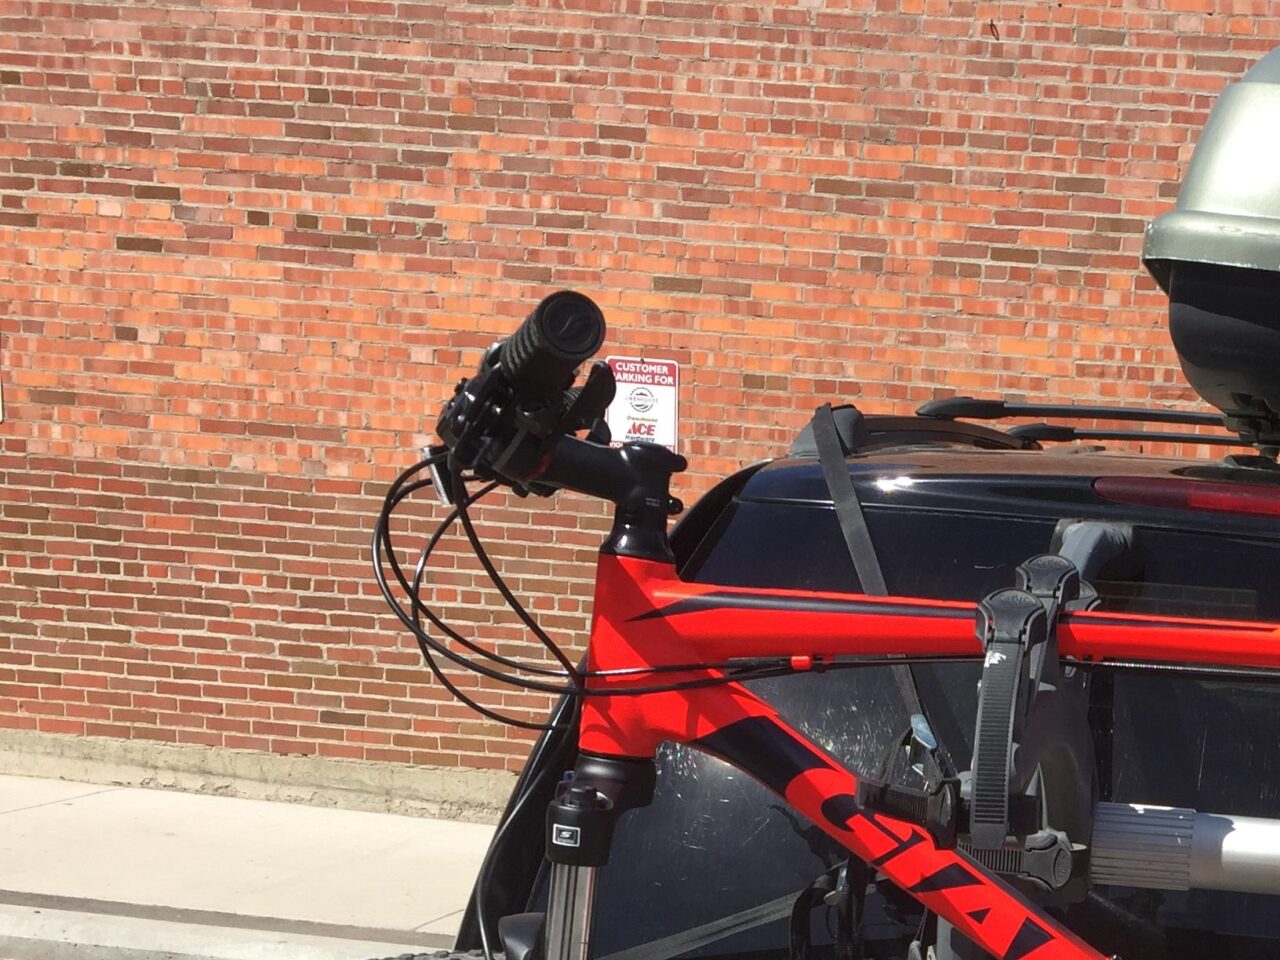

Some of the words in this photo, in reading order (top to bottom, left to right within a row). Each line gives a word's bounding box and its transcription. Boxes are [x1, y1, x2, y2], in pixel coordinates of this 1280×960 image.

[615, 362, 668, 374] CUSTOMER
[654, 376, 674, 384] FOR
[627, 422, 656, 436] ACE
[625, 434, 655, 443] Hardware
